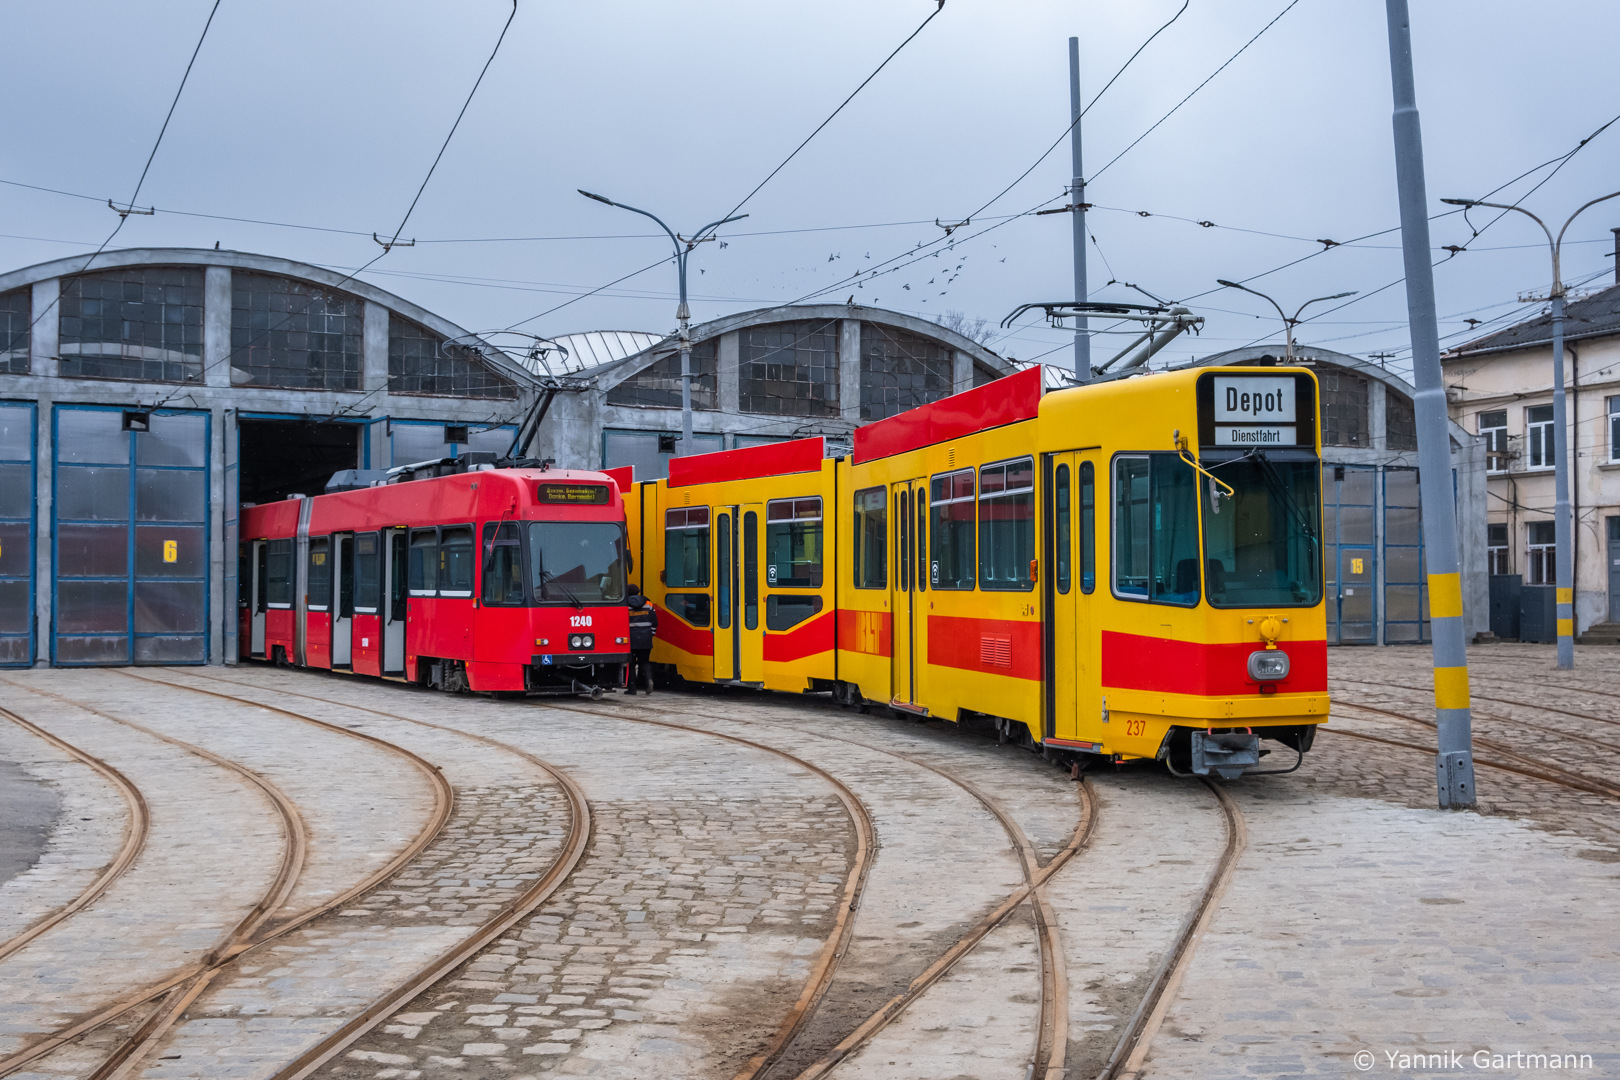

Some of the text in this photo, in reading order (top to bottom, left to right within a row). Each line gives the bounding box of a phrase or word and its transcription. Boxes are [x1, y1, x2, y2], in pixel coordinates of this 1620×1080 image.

[1226, 387, 1283, 416] Depot
[1231, 429, 1281, 443] Dienstfahrt
[163, 540, 178, 563] 6
[1351, 558, 1364, 574] 15
[569, 615, 593, 627] 1240
[1126, 719, 1146, 737] 237
